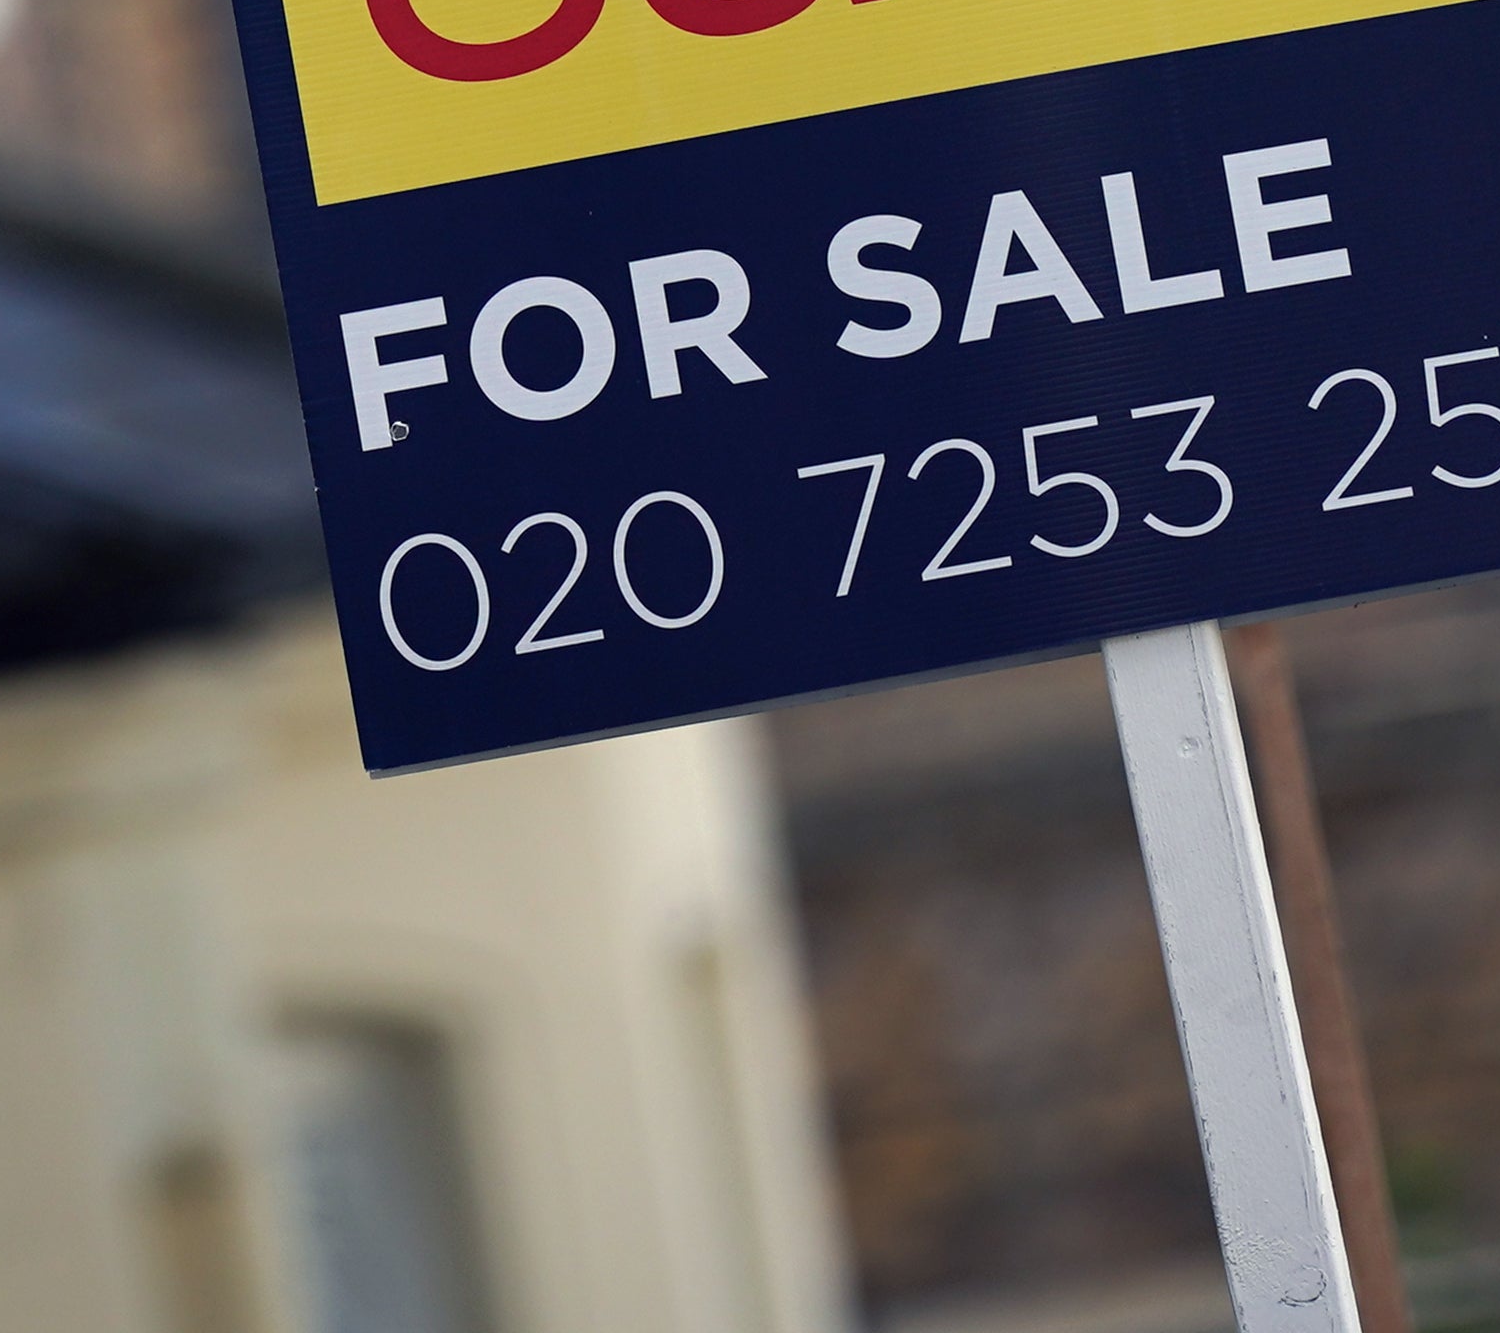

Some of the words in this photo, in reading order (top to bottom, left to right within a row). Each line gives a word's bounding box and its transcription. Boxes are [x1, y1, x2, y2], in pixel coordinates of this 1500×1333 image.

[338, 248, 770, 453] FOR
[826, 136, 1353, 360] SALE
[378, 489, 725, 672] 020
[796, 394, 1235, 599] 7253
